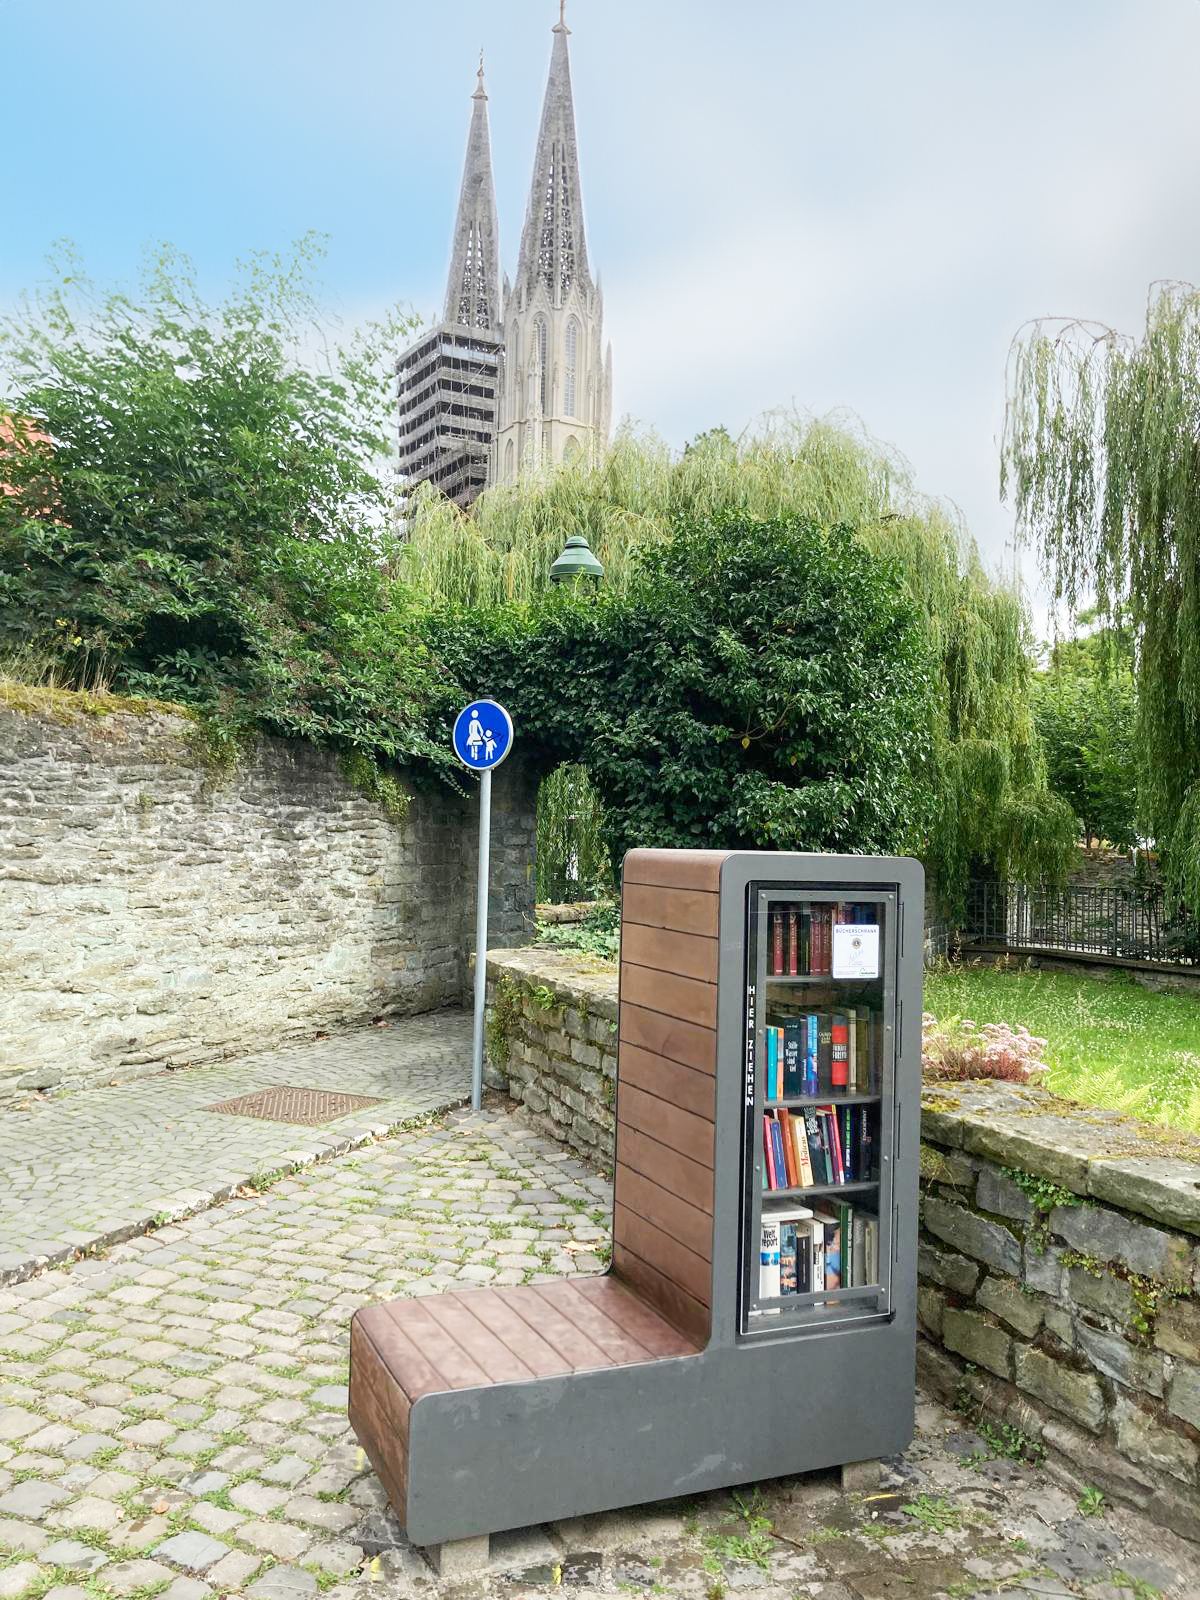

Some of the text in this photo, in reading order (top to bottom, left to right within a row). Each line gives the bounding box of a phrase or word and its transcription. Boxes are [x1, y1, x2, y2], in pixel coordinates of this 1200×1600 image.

[800, 1136, 810, 1168] Medicus
[764, 1230, 776, 1238] Welt
[762, 1238, 778, 1248] report
